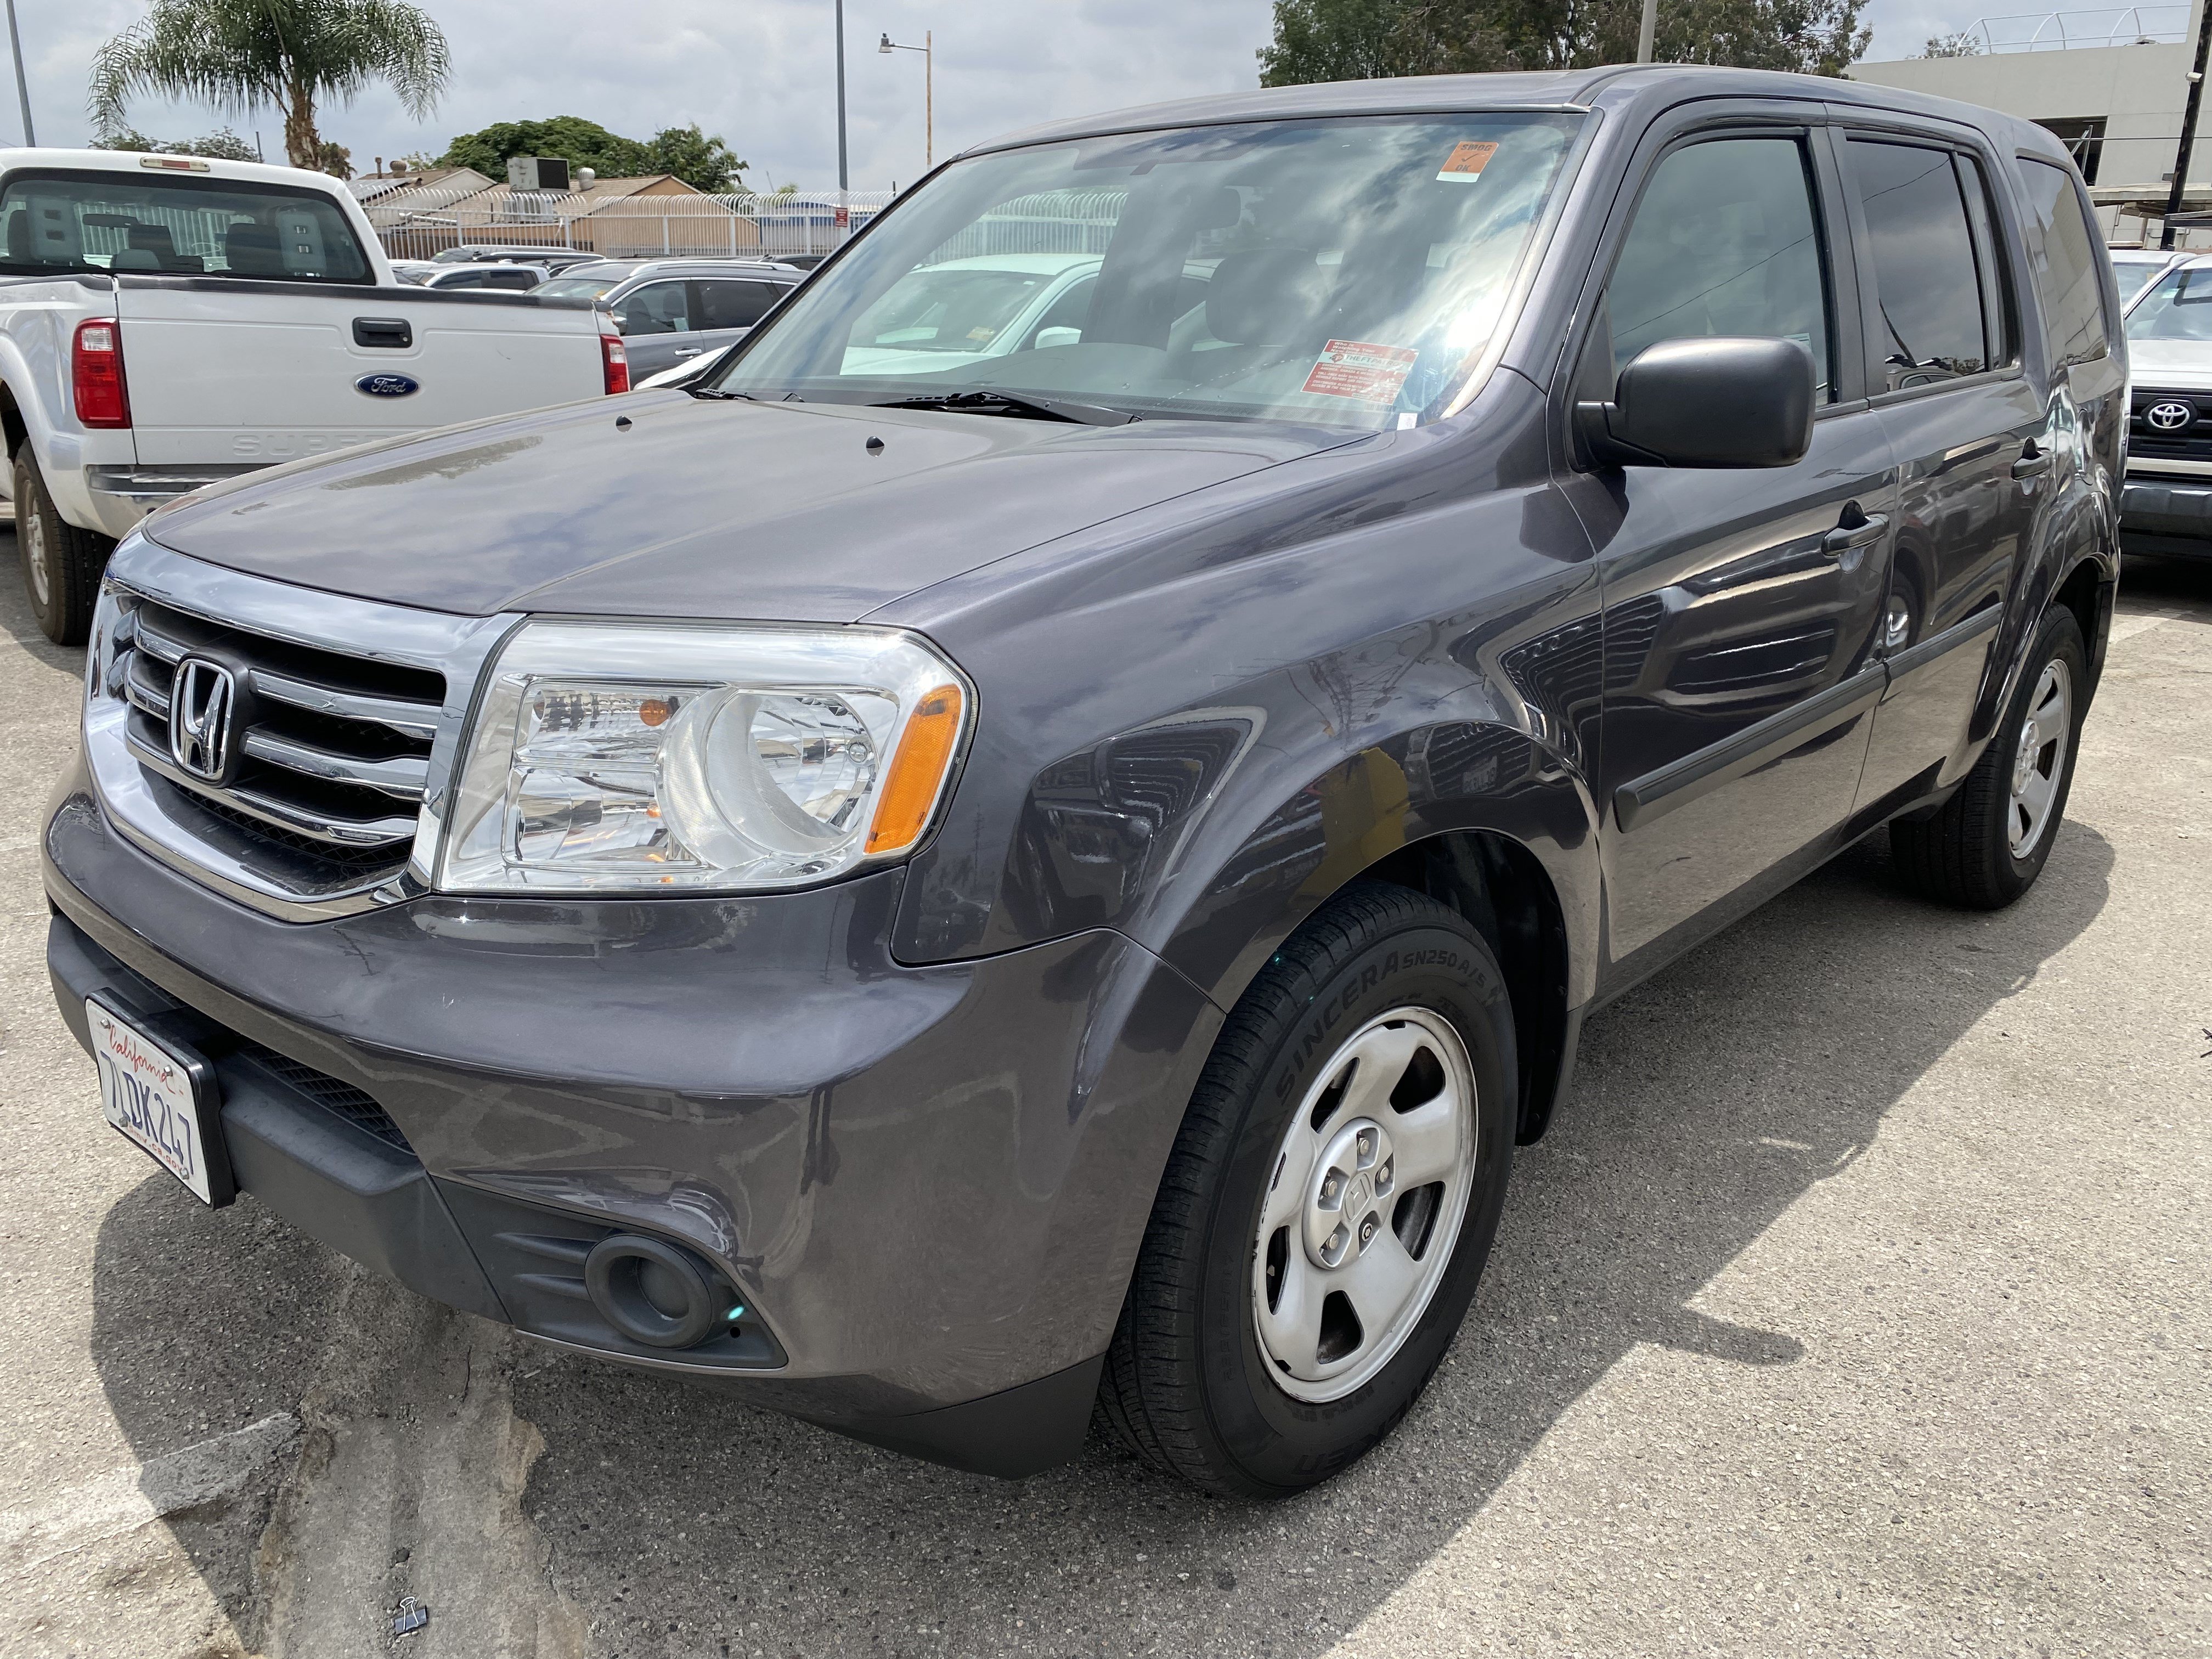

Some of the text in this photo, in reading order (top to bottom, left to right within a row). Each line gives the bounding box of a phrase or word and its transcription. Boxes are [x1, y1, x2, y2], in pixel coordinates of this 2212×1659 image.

[371, 377, 406, 392] Ford
[109, 1024, 176, 1094] California
[1275, 951, 1398, 1105] SINCERA
[1402, 949, 1458, 969] SN250
[100, 1049, 194, 1176] 7LDK247
